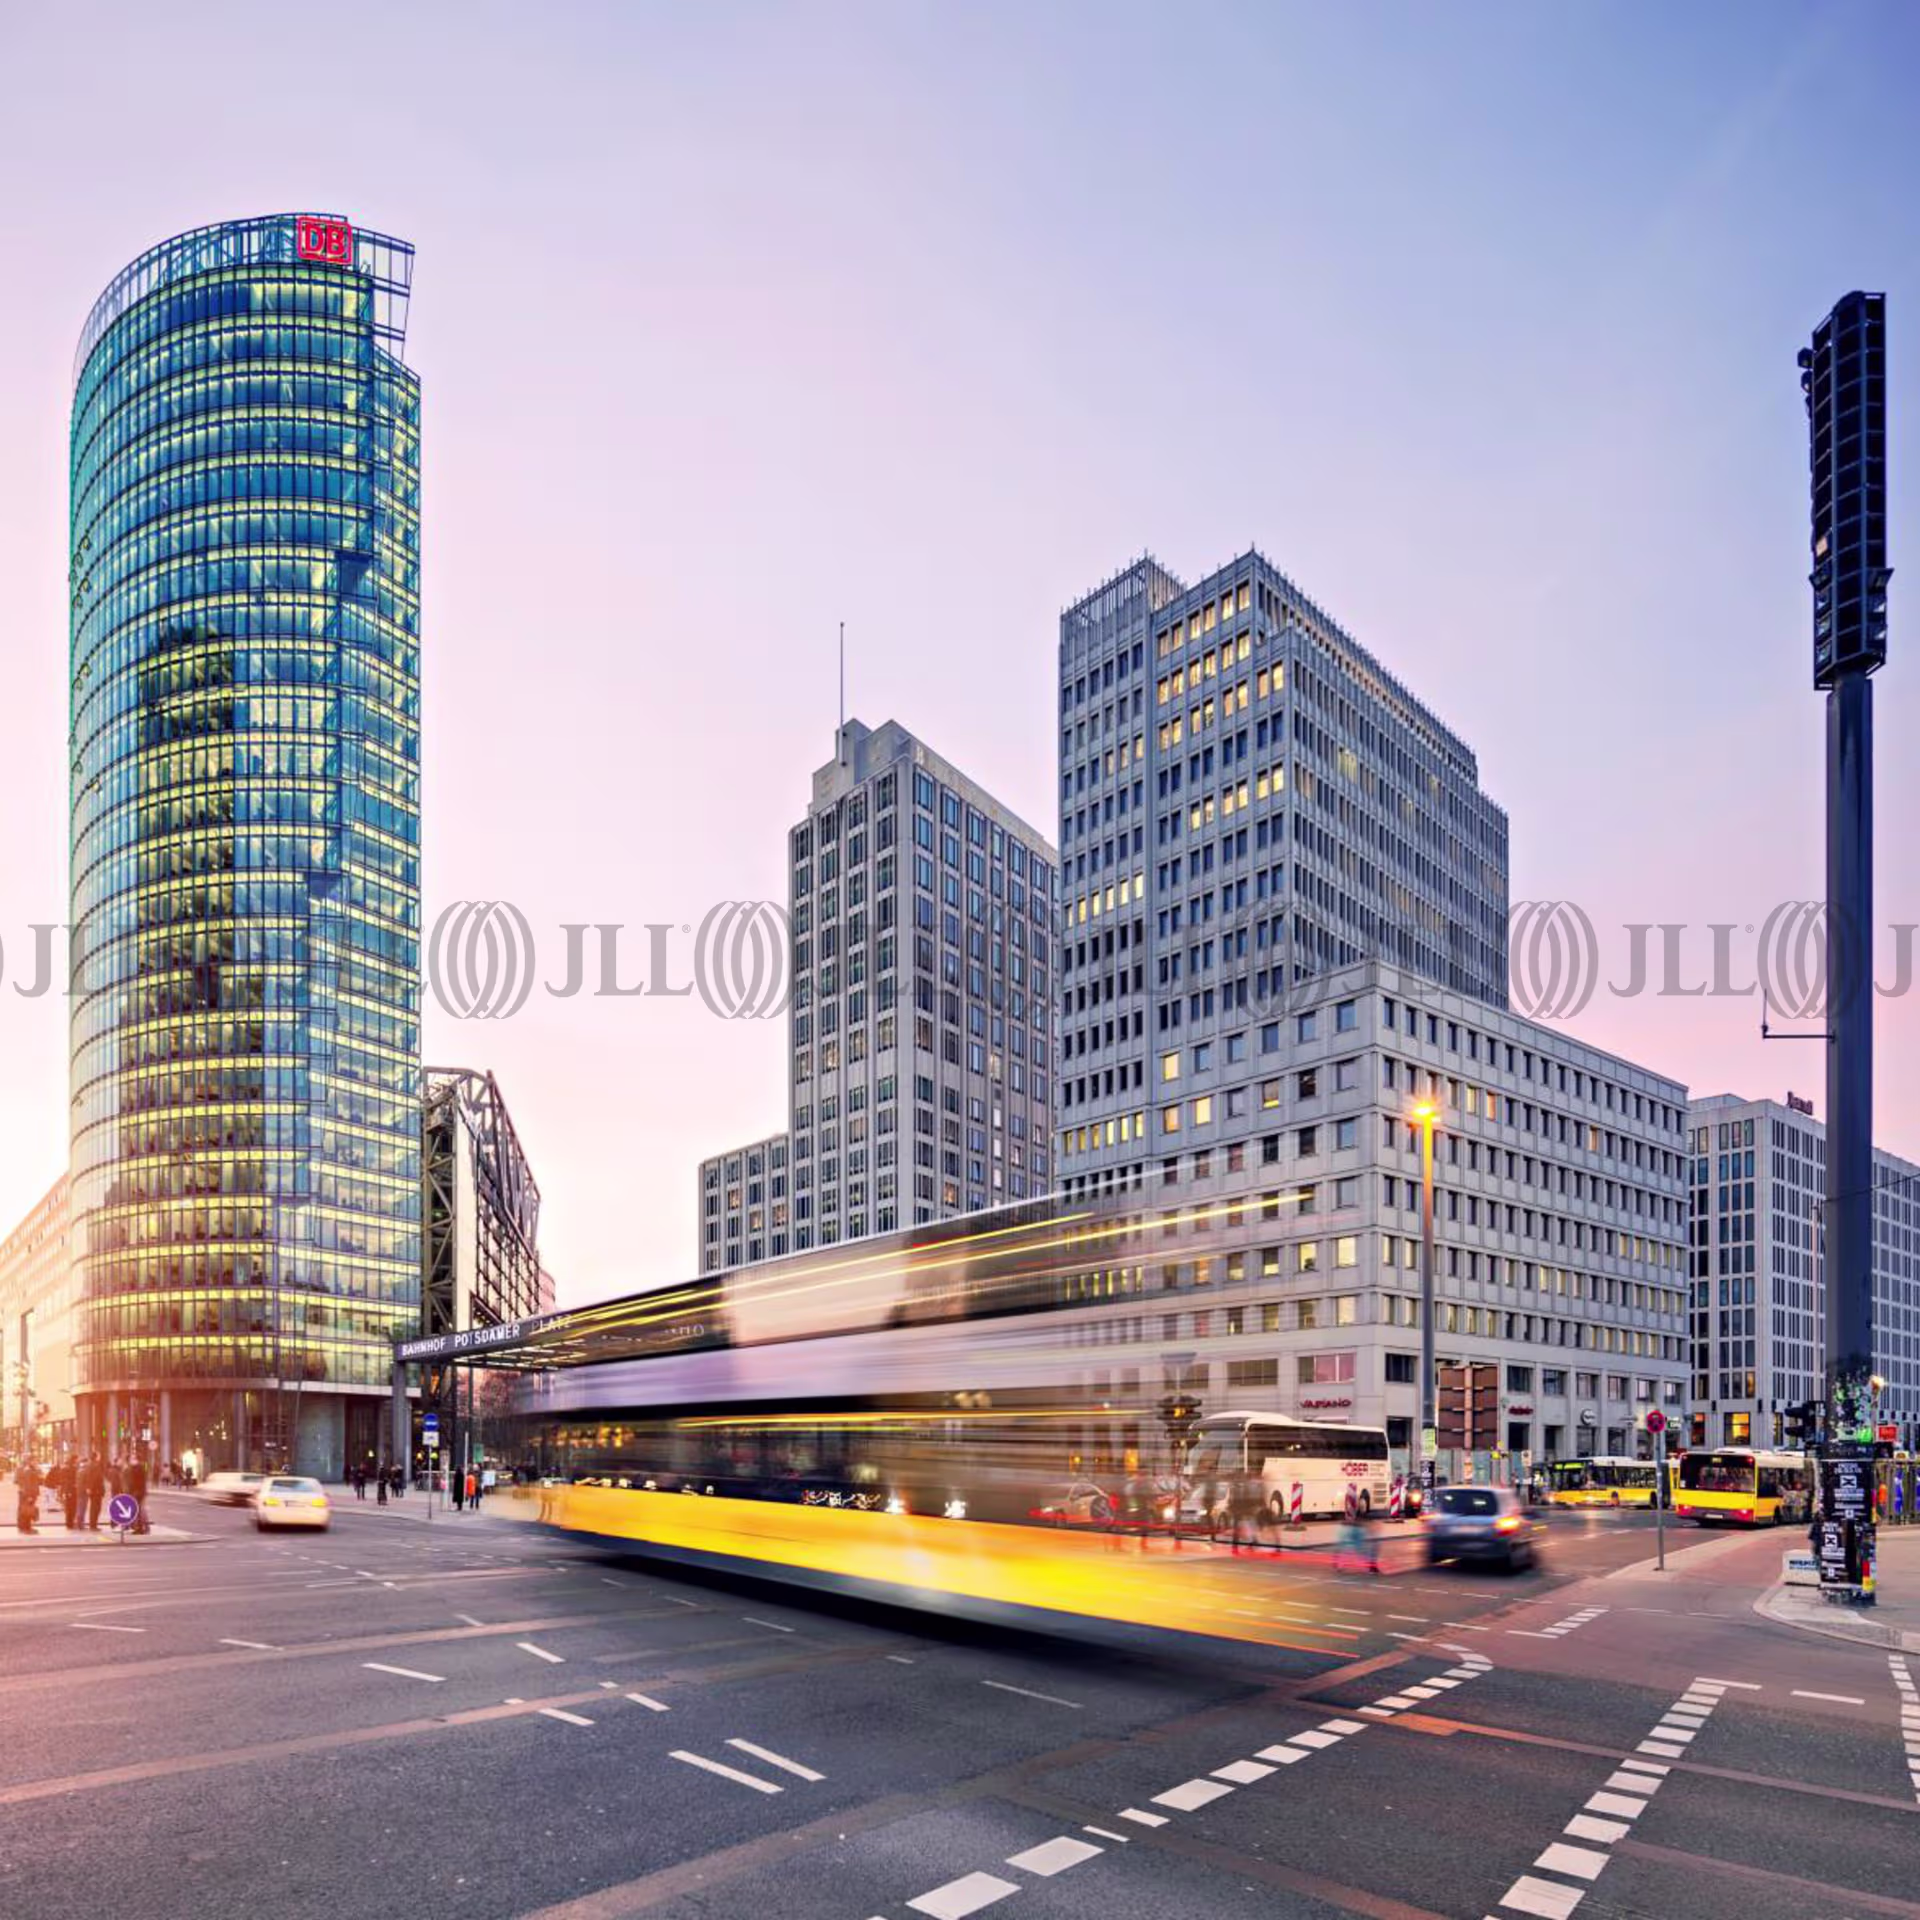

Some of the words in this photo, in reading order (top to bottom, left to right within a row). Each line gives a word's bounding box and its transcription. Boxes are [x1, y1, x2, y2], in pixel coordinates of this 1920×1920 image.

[305, 223, 345, 255] DB
[402, 1339, 446, 1356] BAHNHOF
[454, 1324, 520, 1348] POTSDAMER
